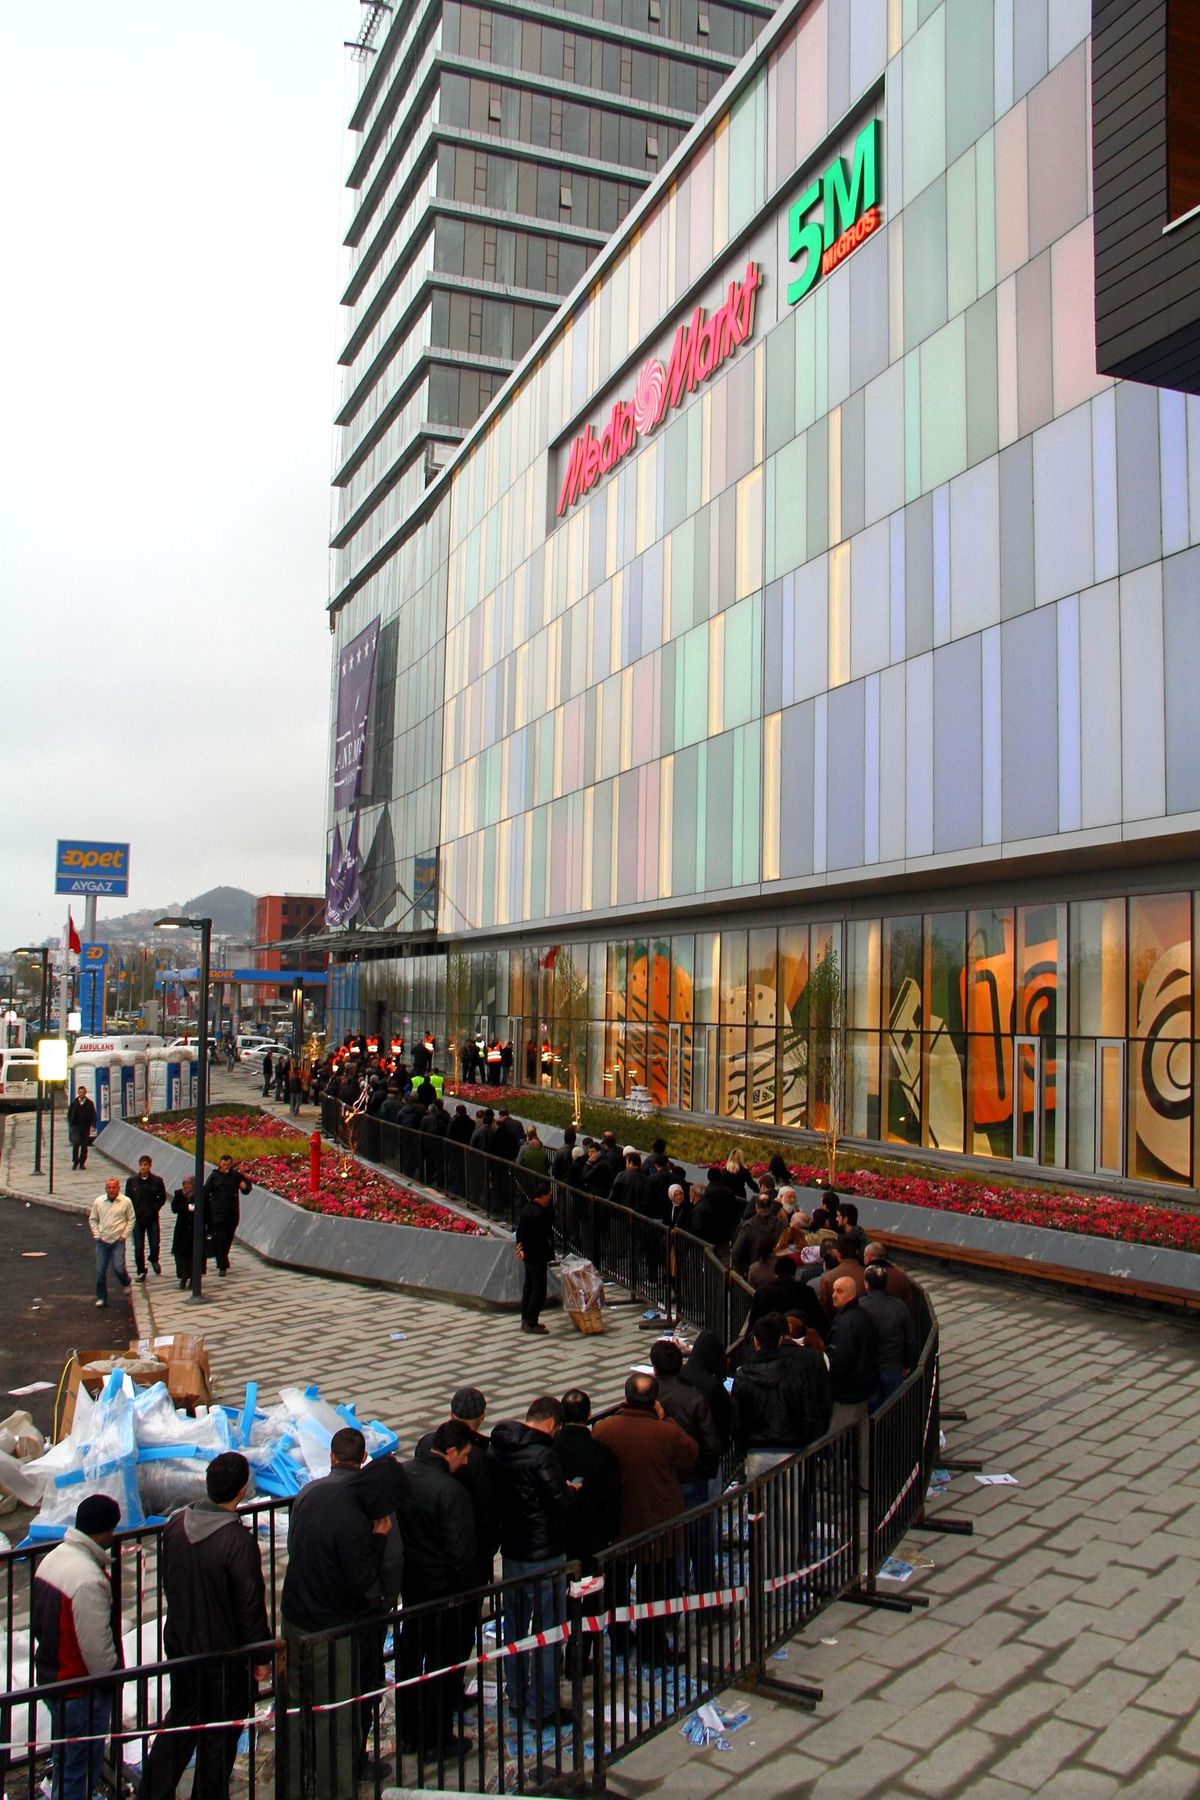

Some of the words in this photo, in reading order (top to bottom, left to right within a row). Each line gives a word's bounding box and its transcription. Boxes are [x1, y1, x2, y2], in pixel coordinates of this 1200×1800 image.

[788, 119, 879, 306] 5M
[71, 881, 113, 892] AYGAZ
[80, 1043, 115, 1051] AMBULANS
